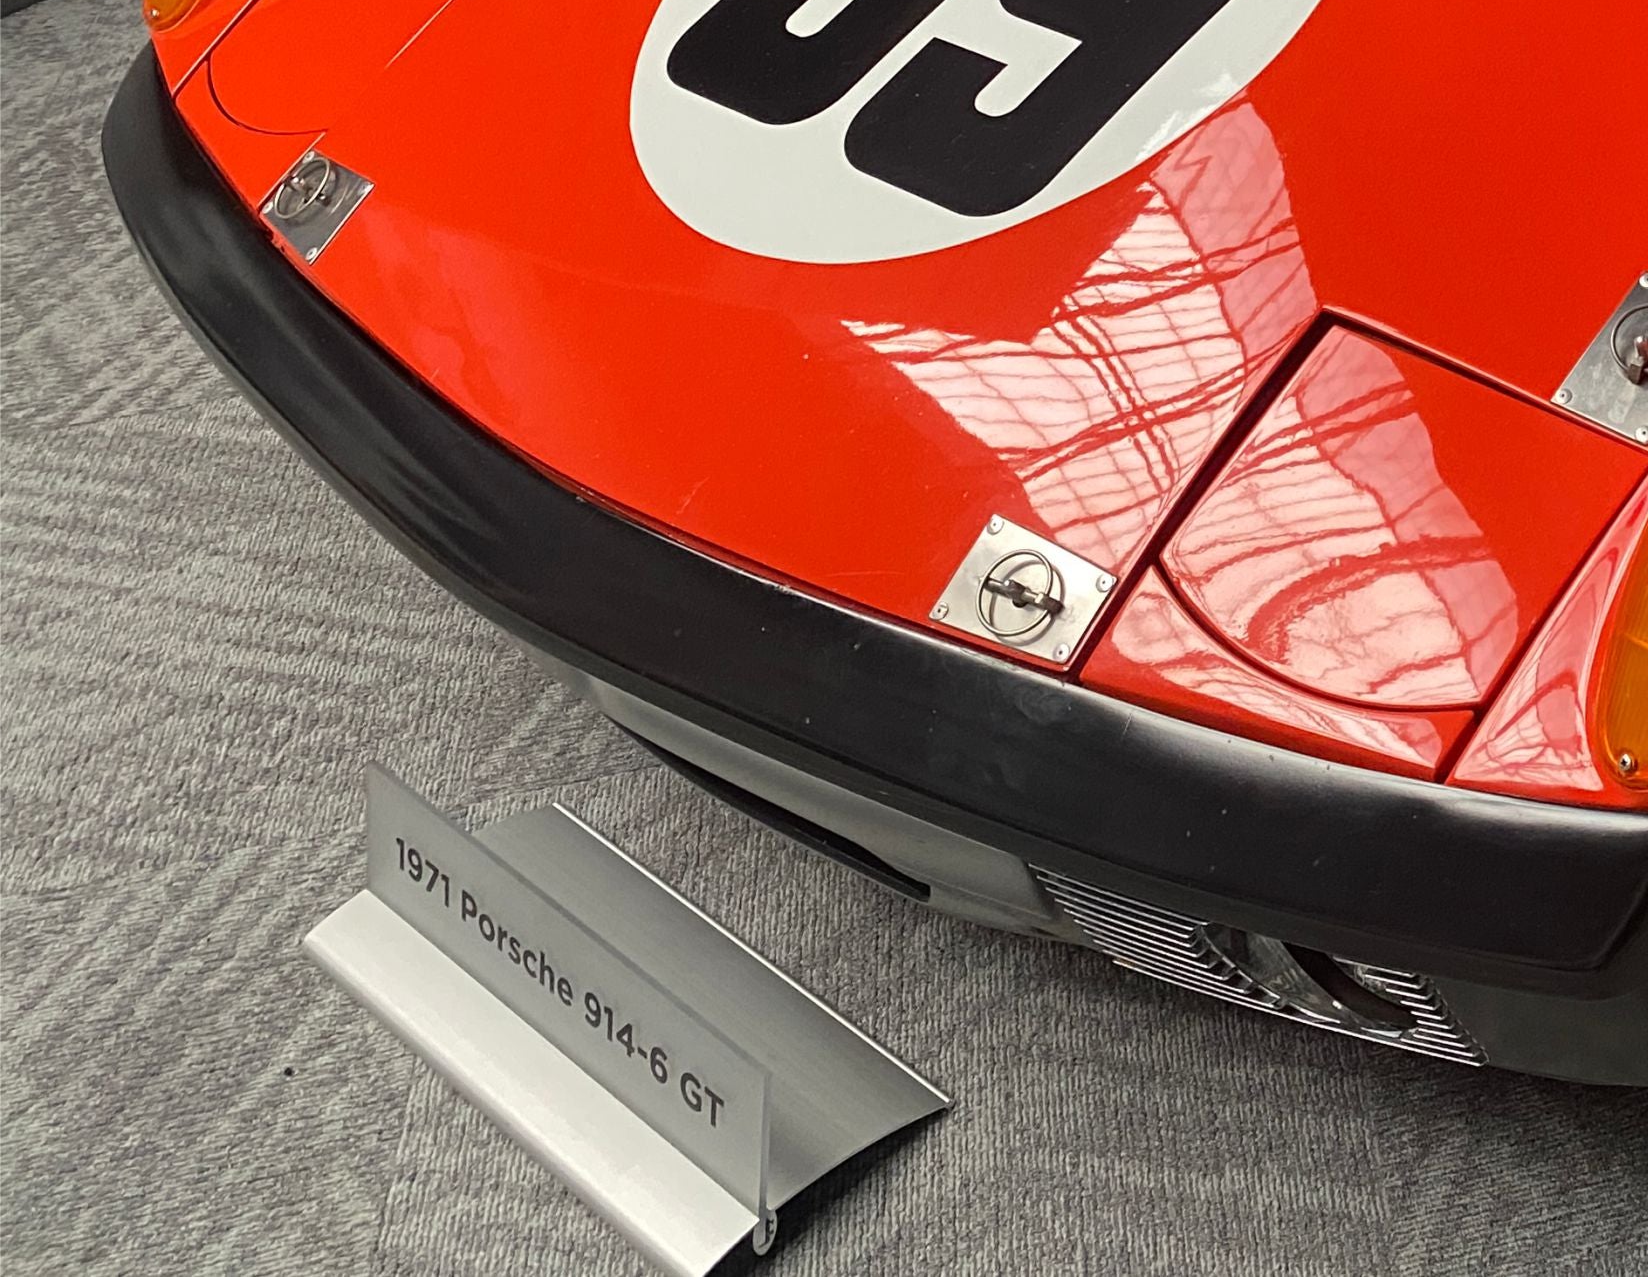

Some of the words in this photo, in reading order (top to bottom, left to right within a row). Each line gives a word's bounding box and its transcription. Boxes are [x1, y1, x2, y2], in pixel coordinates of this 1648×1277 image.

[396, 837, 450, 908] 1971
[461, 889, 573, 1007] Porsche
[584, 992, 669, 1085] 914-6
[680, 1072, 725, 1128] GT
